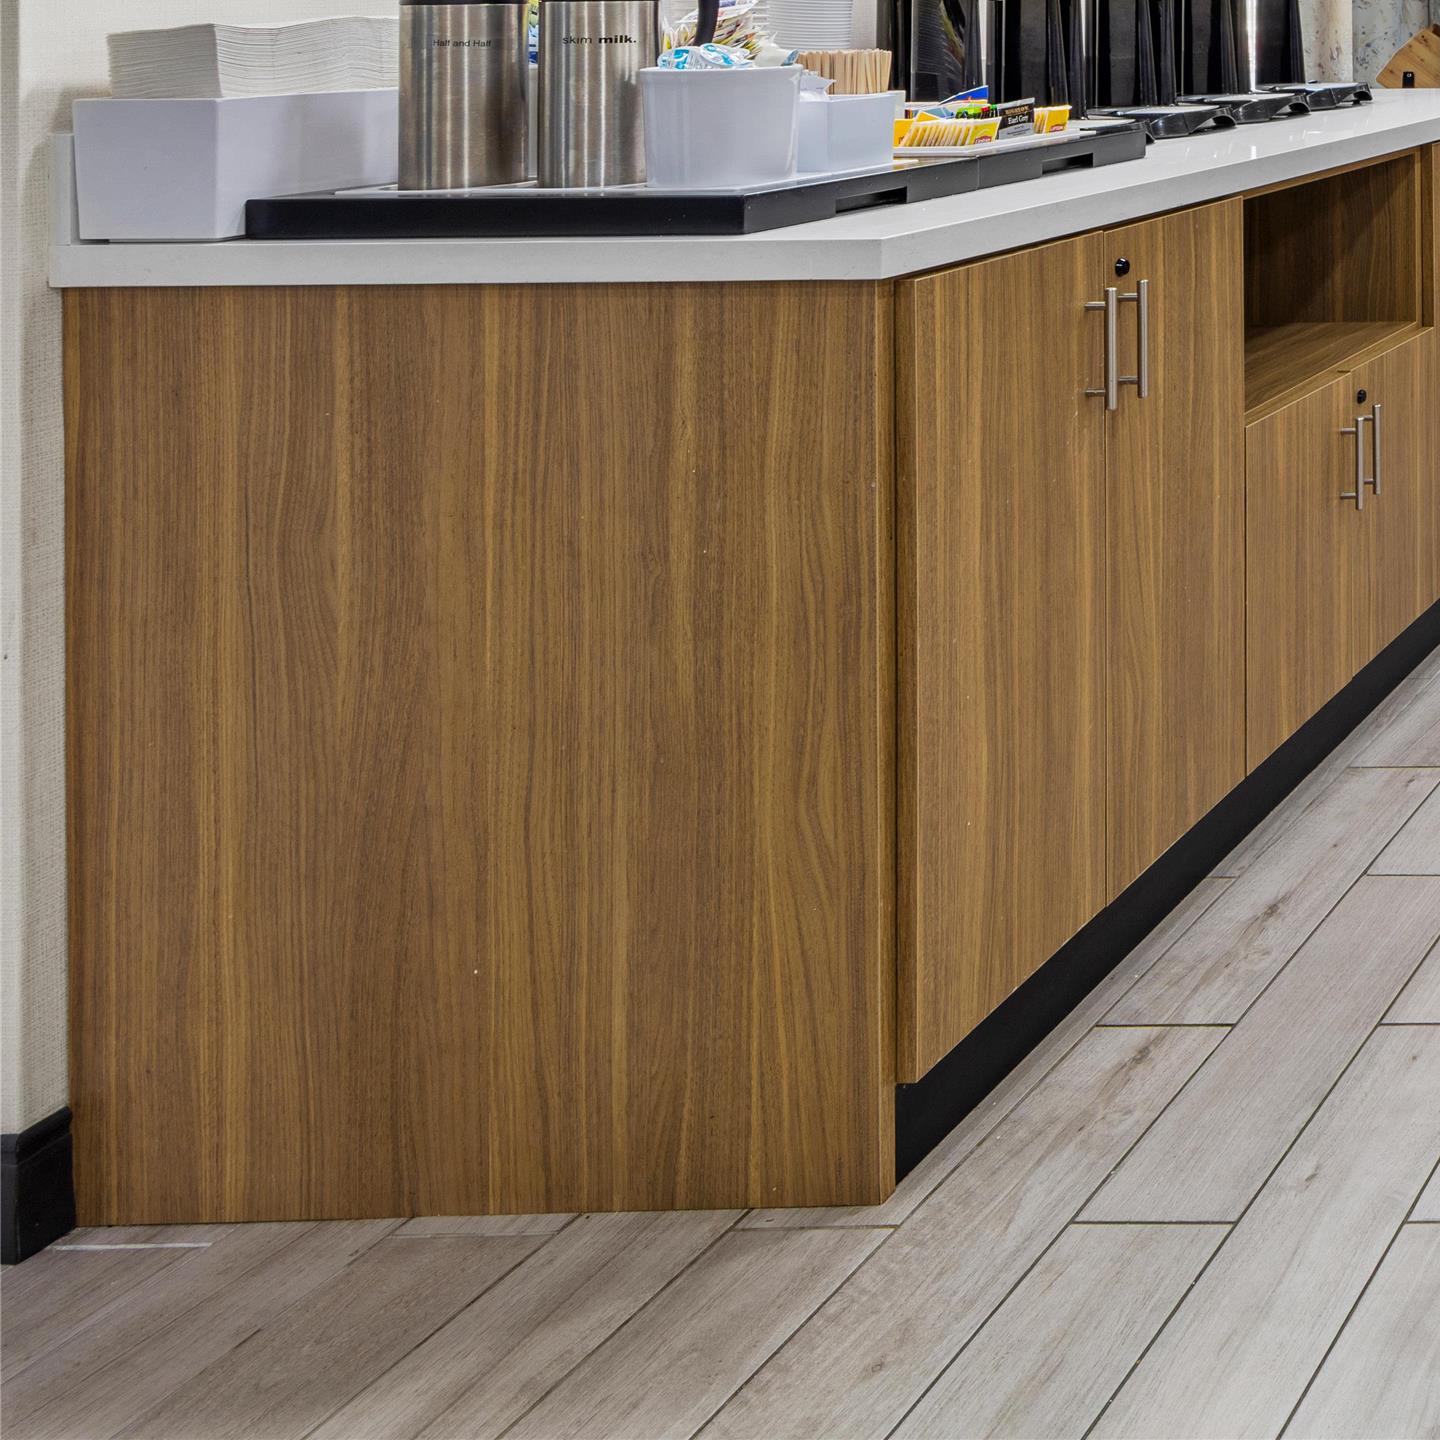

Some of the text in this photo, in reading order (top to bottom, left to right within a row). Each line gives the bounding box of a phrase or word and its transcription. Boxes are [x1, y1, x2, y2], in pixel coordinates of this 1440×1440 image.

[433, 39, 491, 48] Half and Half
[562, 34, 637, 45] skim milk.
[1007, 115, 1029, 125] Earl Grey
